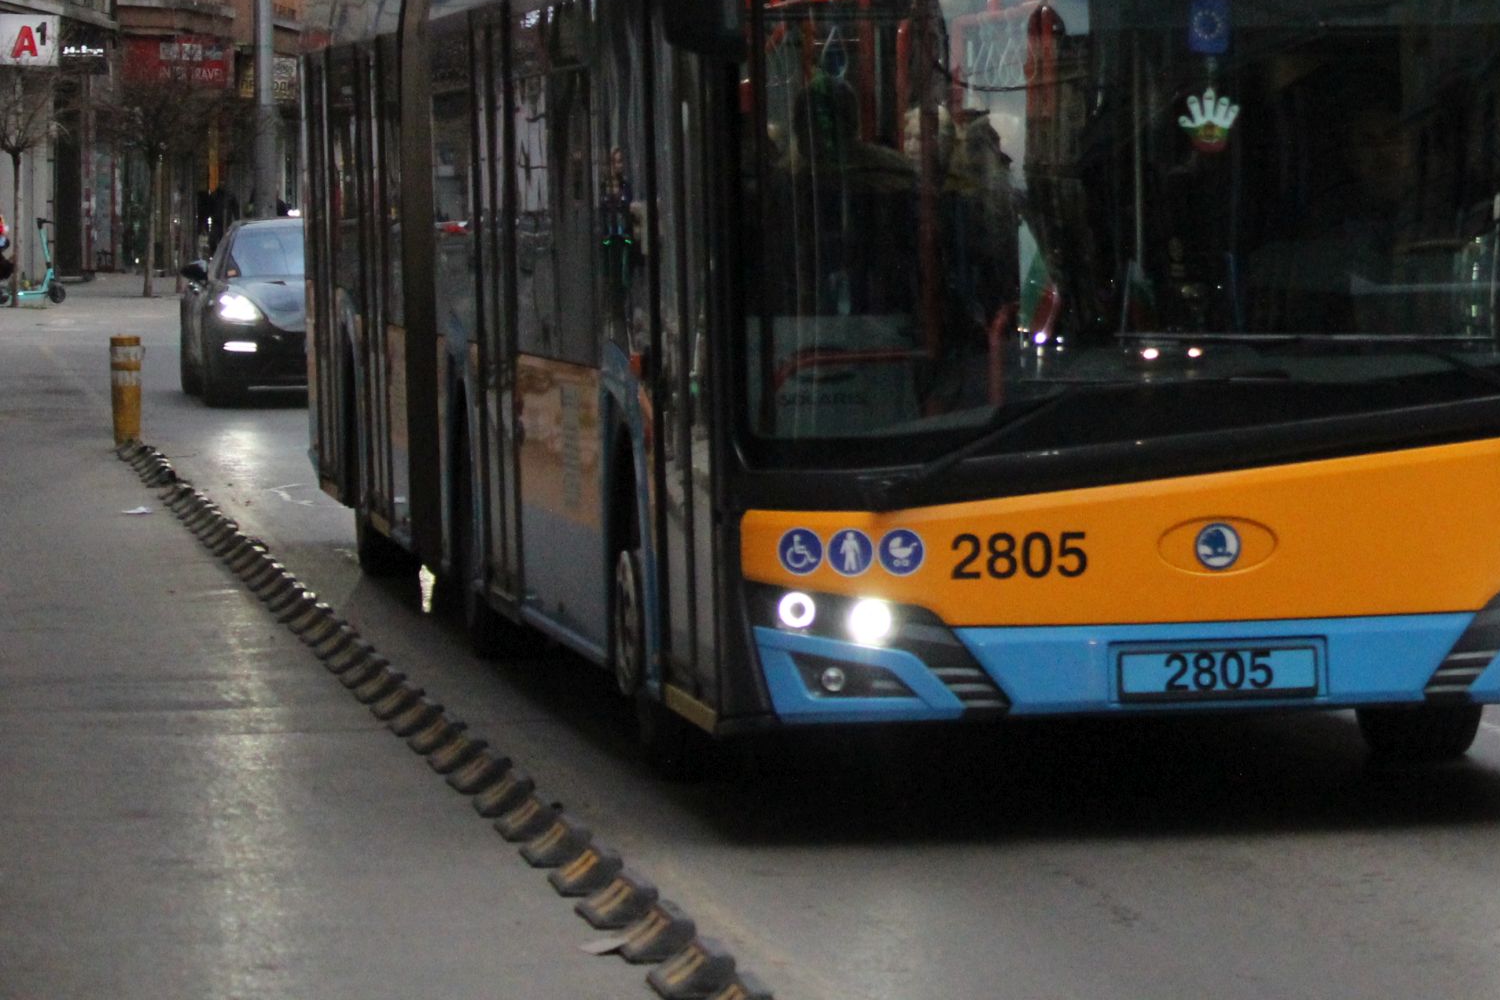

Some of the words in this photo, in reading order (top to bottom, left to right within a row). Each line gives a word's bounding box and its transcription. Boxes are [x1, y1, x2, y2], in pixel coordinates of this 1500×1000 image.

[11, 21, 47, 58] A1
[951, 531, 1088, 580] 2805
[1164, 650, 1274, 692] 2805
